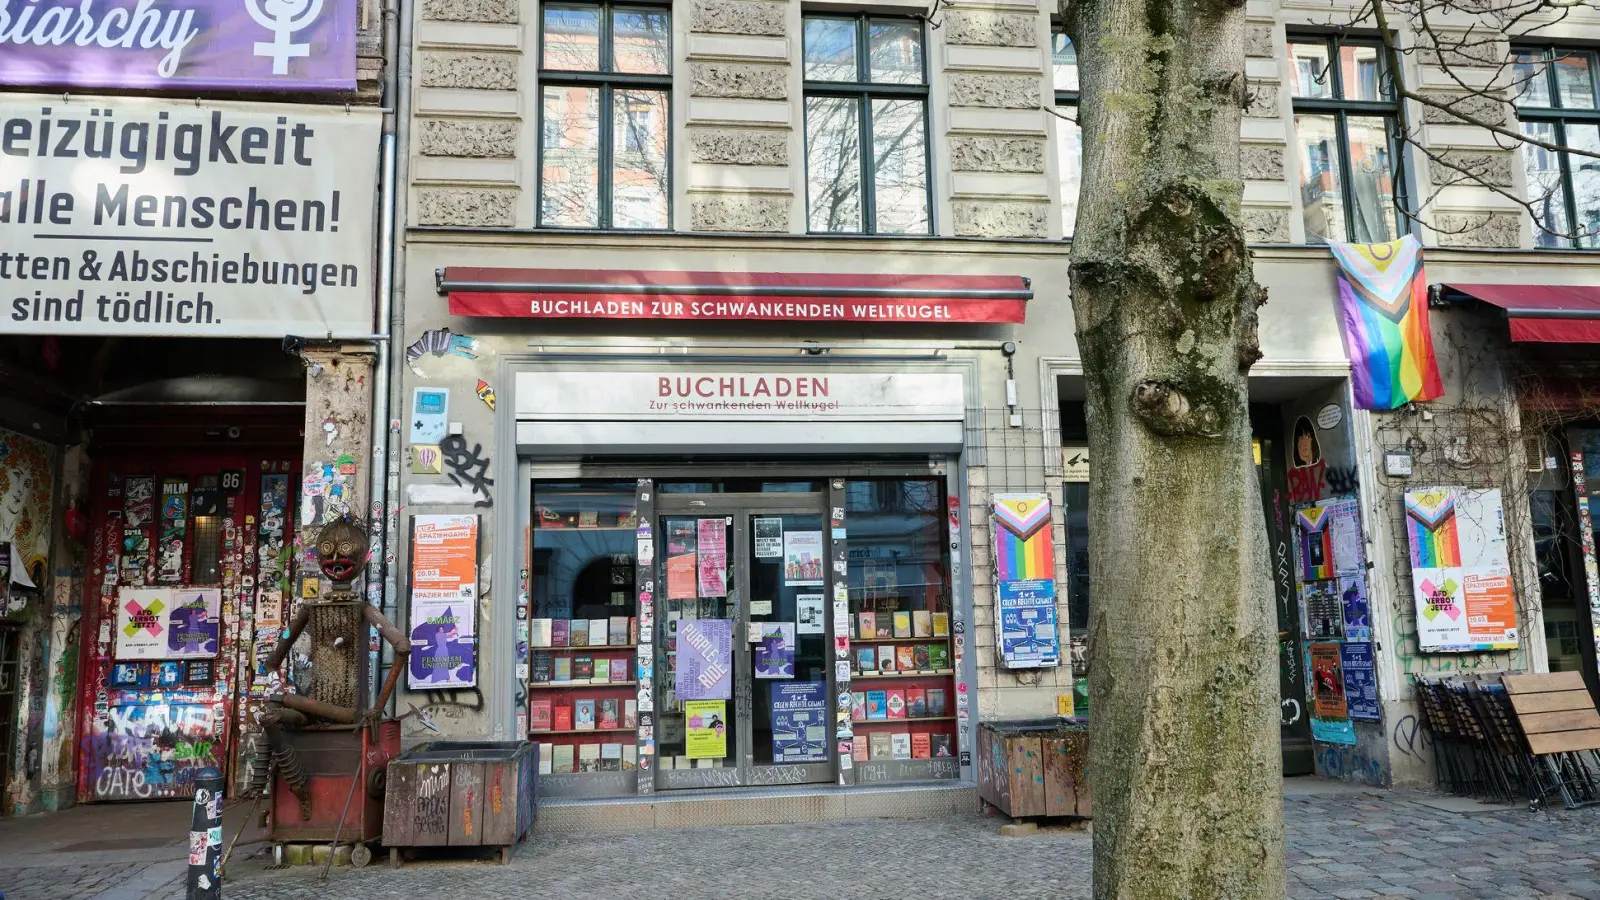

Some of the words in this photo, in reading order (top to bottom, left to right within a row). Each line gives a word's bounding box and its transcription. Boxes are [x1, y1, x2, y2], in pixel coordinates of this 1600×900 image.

[0, 107, 314, 176] eizügigkeit
[94, 183, 340, 233] Menschen!
[79, 250, 103, 281] &
[108, 250, 358, 294] Abschiebungen
[11, 289, 84, 323] sind
[98, 291, 222, 325] tödlich.
[530, 300, 644, 315] BUCHLADEN
[651, 301, 684, 316] ZUR
[691, 302, 845, 318] SCHWANKENDEN
[852, 304, 952, 319] WELTKUGEL
[658, 376, 829, 398] BUCHLADEN
[650, 400, 668, 410] Zur
[673, 400, 771, 410] schwankenden
[776, 400, 839, 412] Weltkugel
[163, 483, 188, 495] MLM
[222, 472, 240, 488] 86
[681, 623, 719, 663] PURPLE
[698, 660, 728, 690] RIDE
